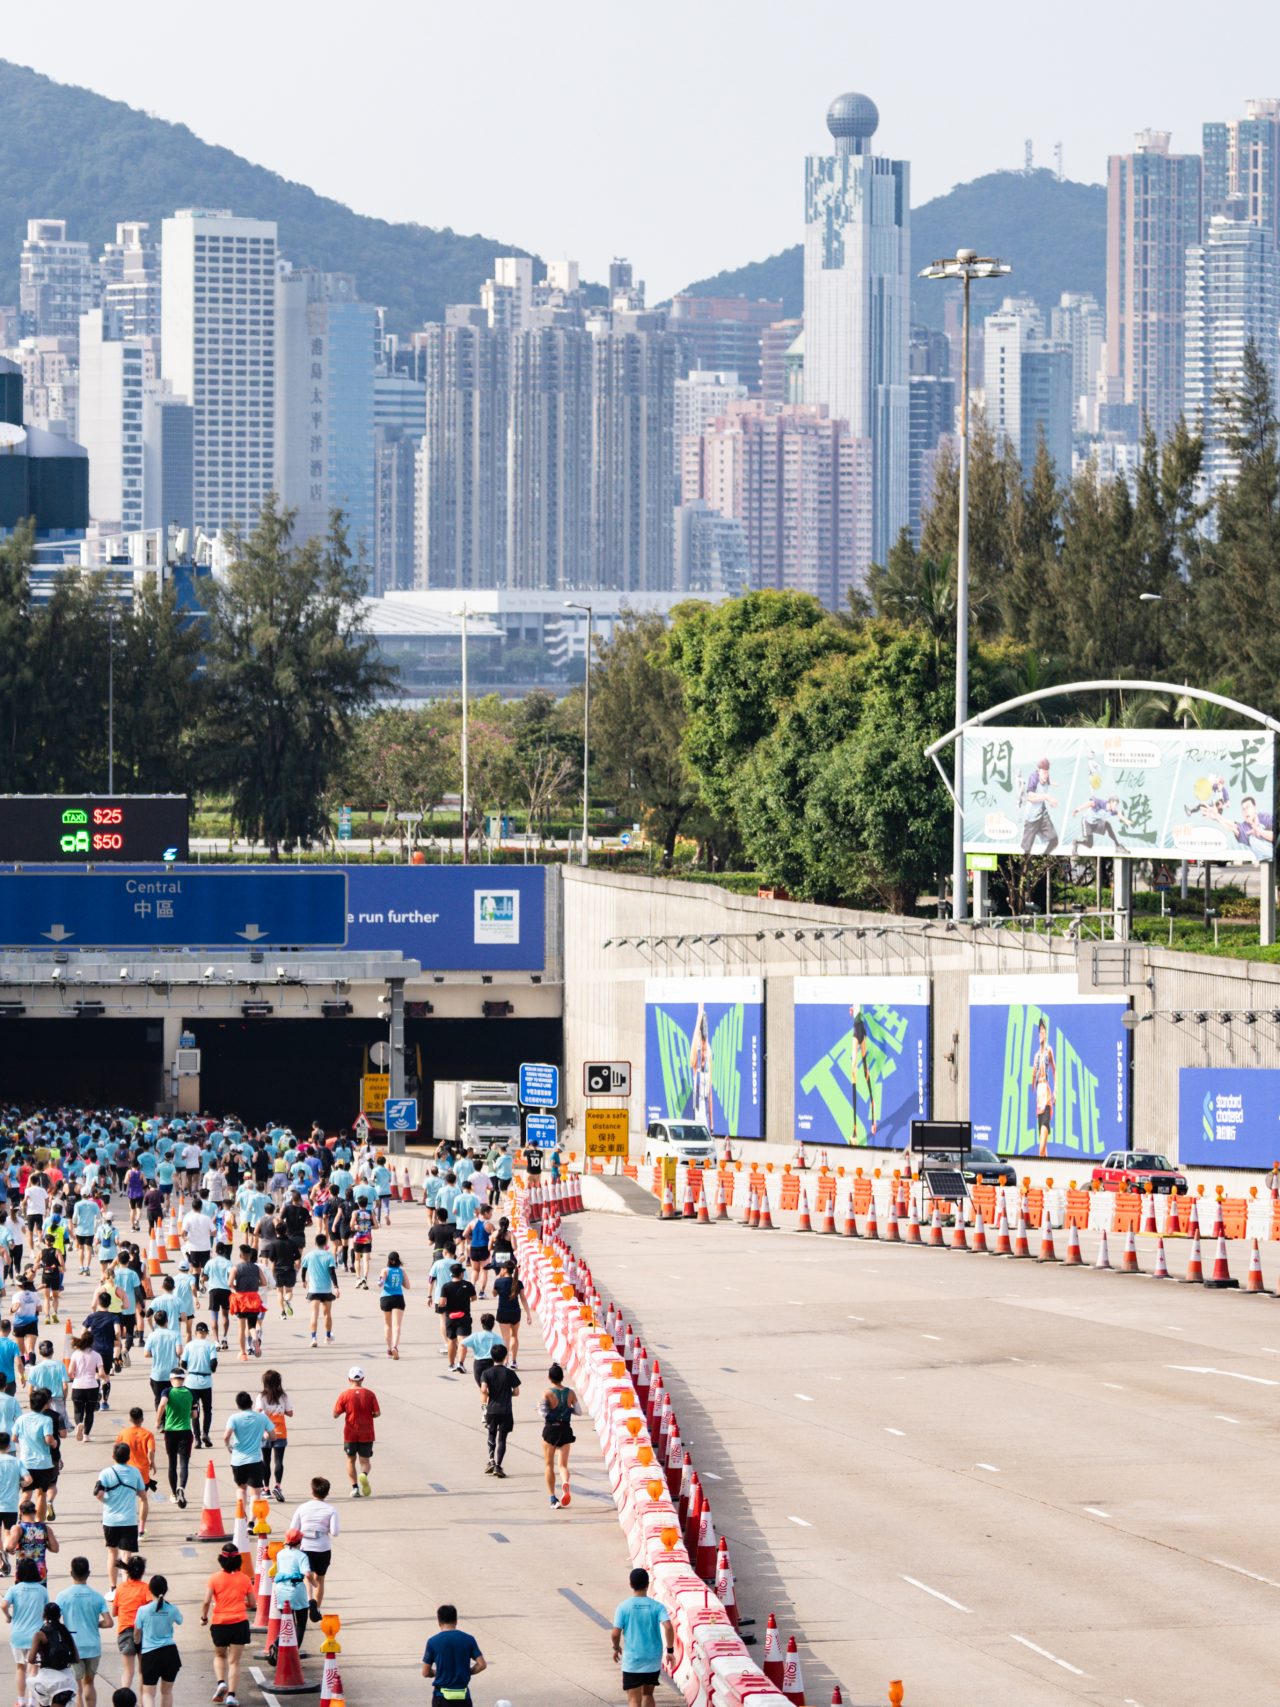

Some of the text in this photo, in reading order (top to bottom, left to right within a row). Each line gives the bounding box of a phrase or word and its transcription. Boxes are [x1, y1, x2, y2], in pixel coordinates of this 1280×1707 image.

[982, 740, 1013, 793] 閃
[1229, 737, 1267, 793] 求
[67, 808, 122, 825] TAXI $25
[1118, 793, 1157, 844] 避
[93, 834, 122, 849] $50
[125, 879, 181, 894] Central
[134, 899, 174, 919] 中區
[359, 913, 383, 923] run
[388, 909, 439, 923] further
[1215, 1093, 1242, 1108] standard
[1215, 1109, 1244, 1123] chartered
[598, 1133, 615, 1141] 保持
[530, 1157, 540, 1167] 10
